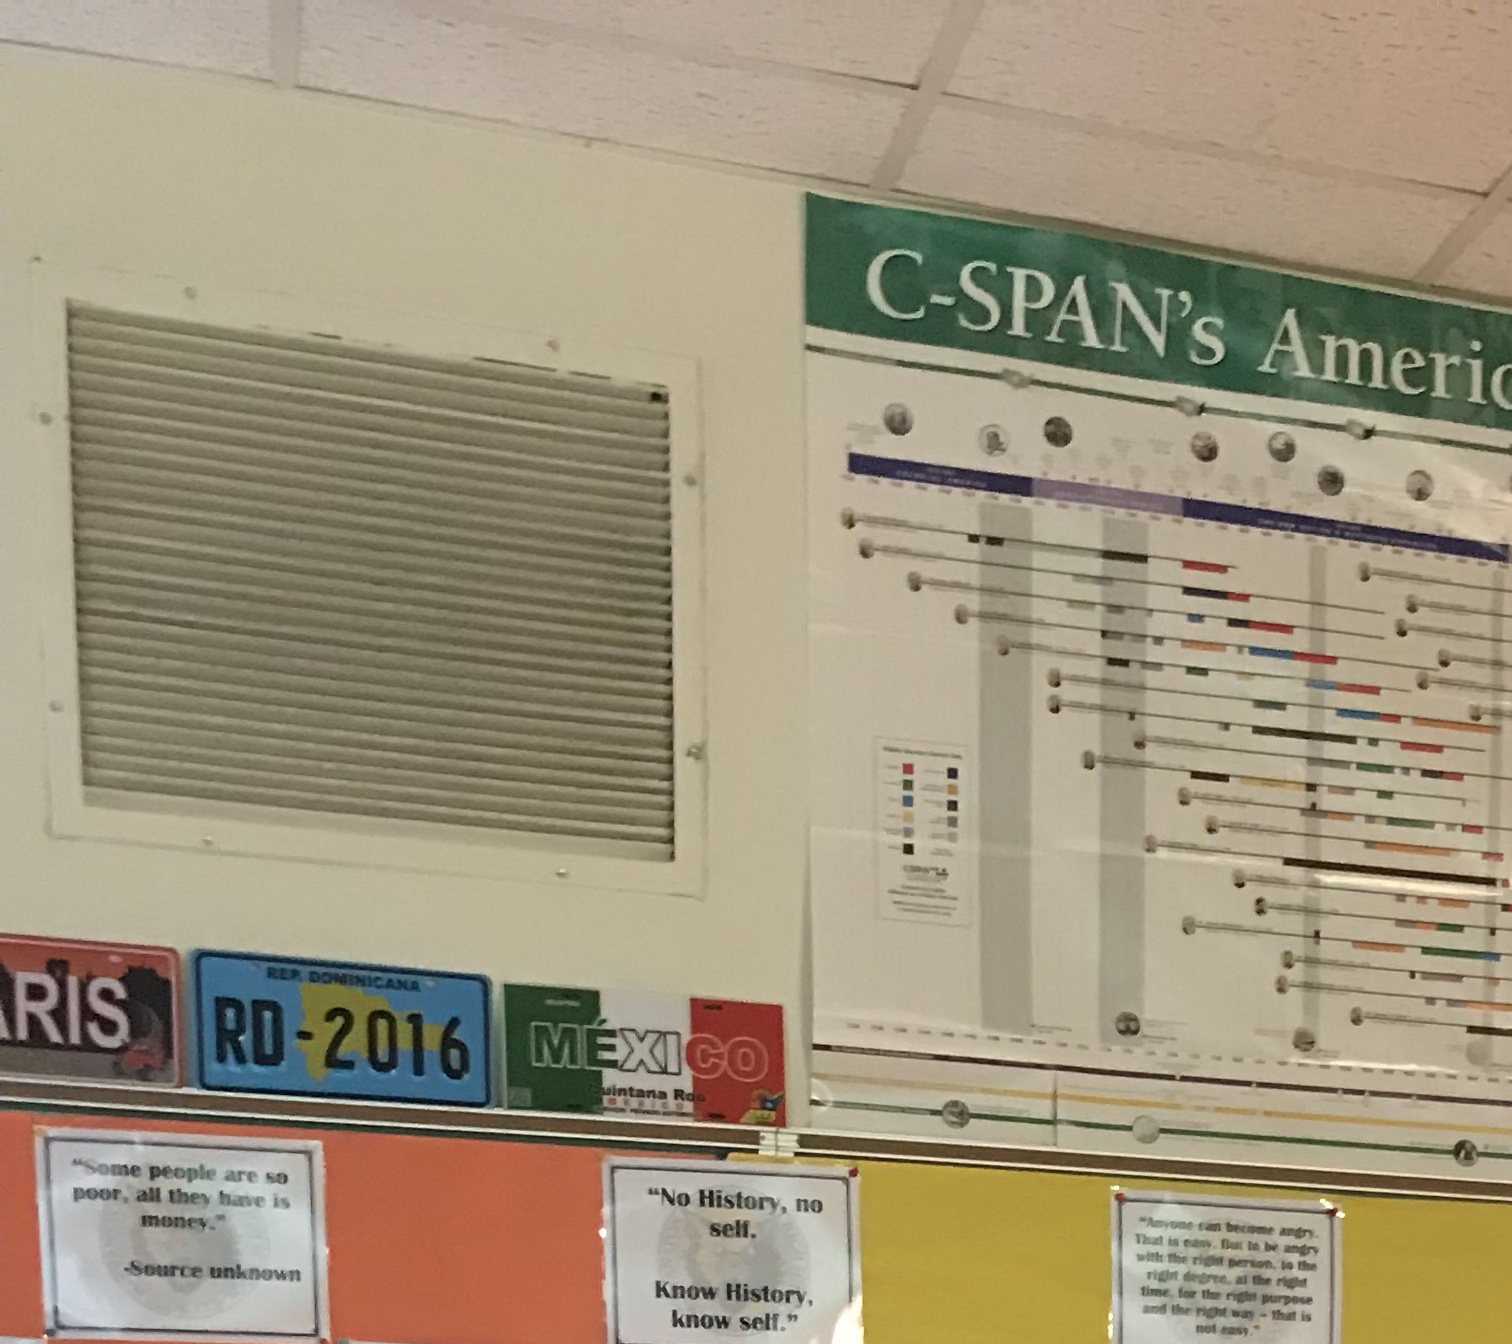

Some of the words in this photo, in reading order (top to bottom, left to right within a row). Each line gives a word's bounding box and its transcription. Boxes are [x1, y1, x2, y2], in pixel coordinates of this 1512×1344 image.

[866, 248, 1226, 366] C-SPAN's
[309, 971, 421, 993] DOMINICANA
[0, 970, 131, 1049] RIS
[215, 996, 470, 1080] RD-2016
[530, 1018, 768, 1082] MÉXICO
[594, 1084, 668, 1100] uintana
[149, 1164, 217, 1183] people
[224, 1169, 258, 1184] are
[266, 1172, 288, 1185] so
[73, 1186, 129, 1204] poor,
[136, 1187, 161, 1203] all
[168, 1188, 210, 1208] they
[219, 1189, 265, 1207] have
[273, 1193, 291, 1209] is
[648, 1187, 690, 1207] "No
[699, 1189, 788, 1214] History,
[795, 1197, 824, 1214] no
[709, 1219, 757, 1239] self.
[124, 1259, 203, 1278] -Source
[209, 1264, 302, 1282] unknown
[655, 1280, 718, 1301] Know
[726, 1283, 813, 1308] History,
[672, 1310, 733, 1329] know
[739, 1313, 798, 1332] self."
